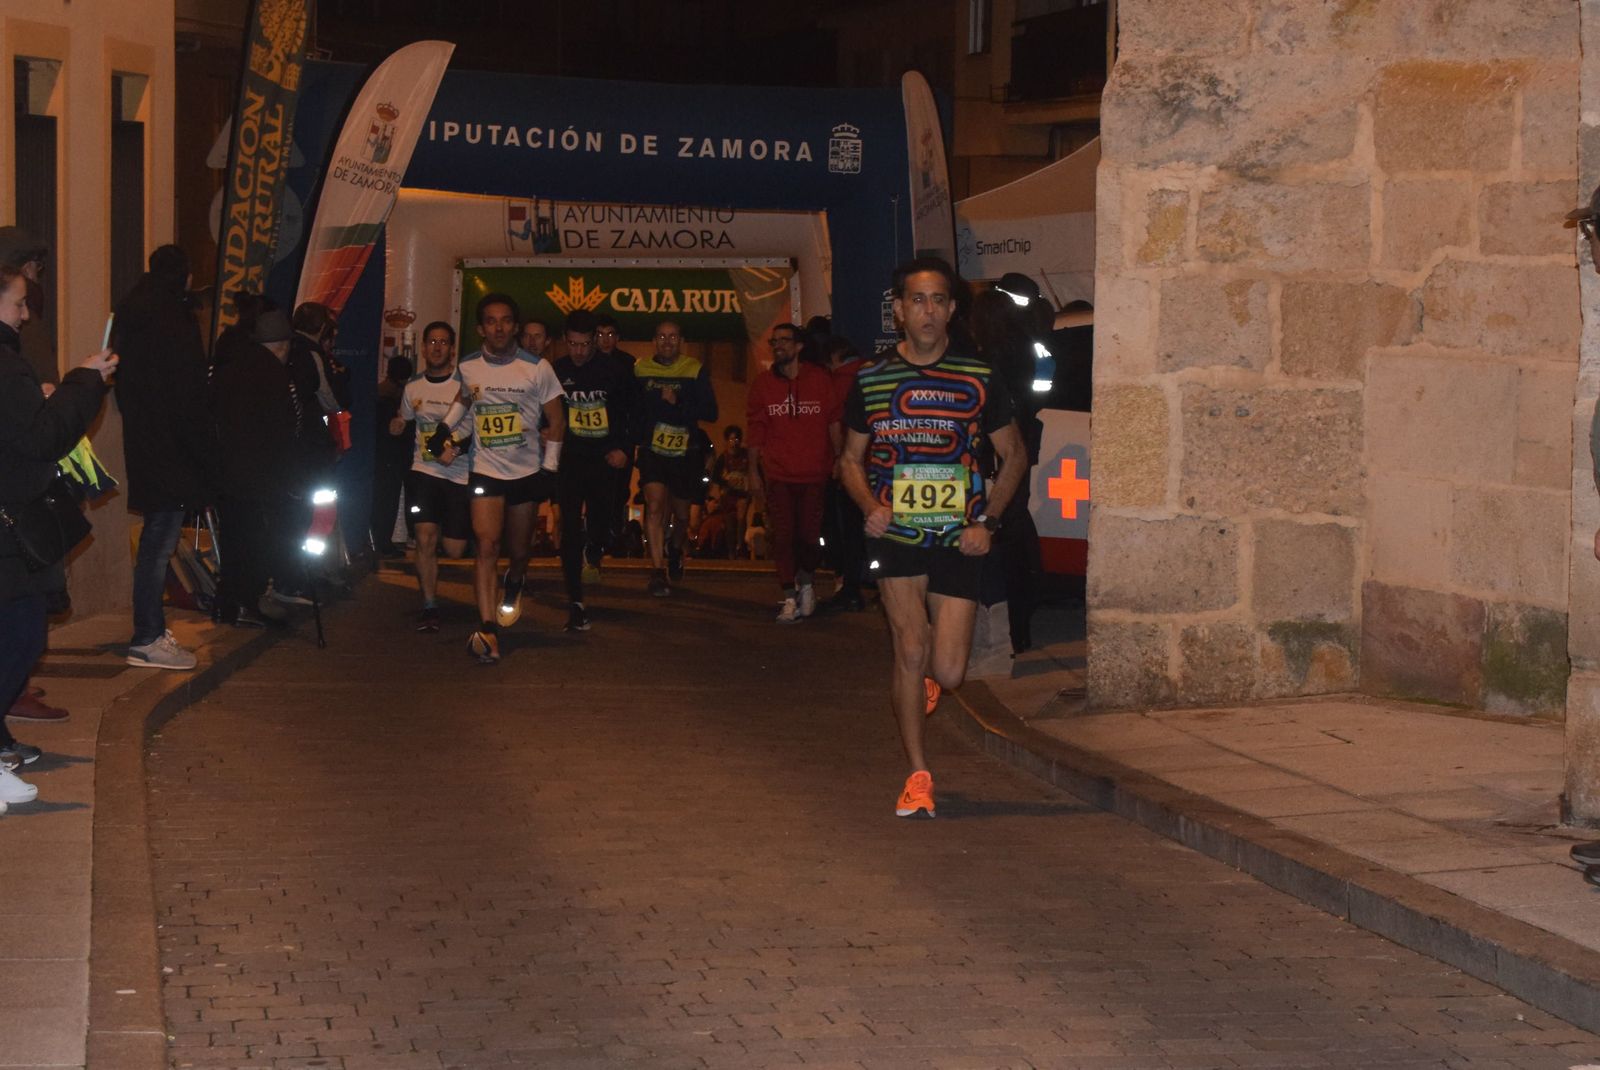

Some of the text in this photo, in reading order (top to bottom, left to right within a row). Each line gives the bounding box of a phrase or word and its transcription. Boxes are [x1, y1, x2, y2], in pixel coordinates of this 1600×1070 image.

[428, 120, 814, 162] IPUTACIÓN DE ZAMORA
[252, 102, 286, 246] RURAL
[338, 155, 402, 183] AYUNTAMIENTO
[333, 166, 397, 195] DE ZAMORA
[216, 87, 265, 337] UNDACION
[563, 204, 735, 224] AYUNTAMIENTO
[564, 229, 736, 249] DE ZAMORA
[975, 238, 1032, 256] SmartChip
[610, 286, 743, 314] CAJA RUR
[911, 389, 956, 403] XXXVIII
[481, 415, 515, 434] 497
[574, 410, 603, 427] 413
[891, 418, 956, 432] SILVESTRE
[656, 432, 684, 448] 473
[873, 432, 943, 444] ALMANTINA
[900, 483, 957, 509] 492
[913, 515, 933, 523] CAJA
